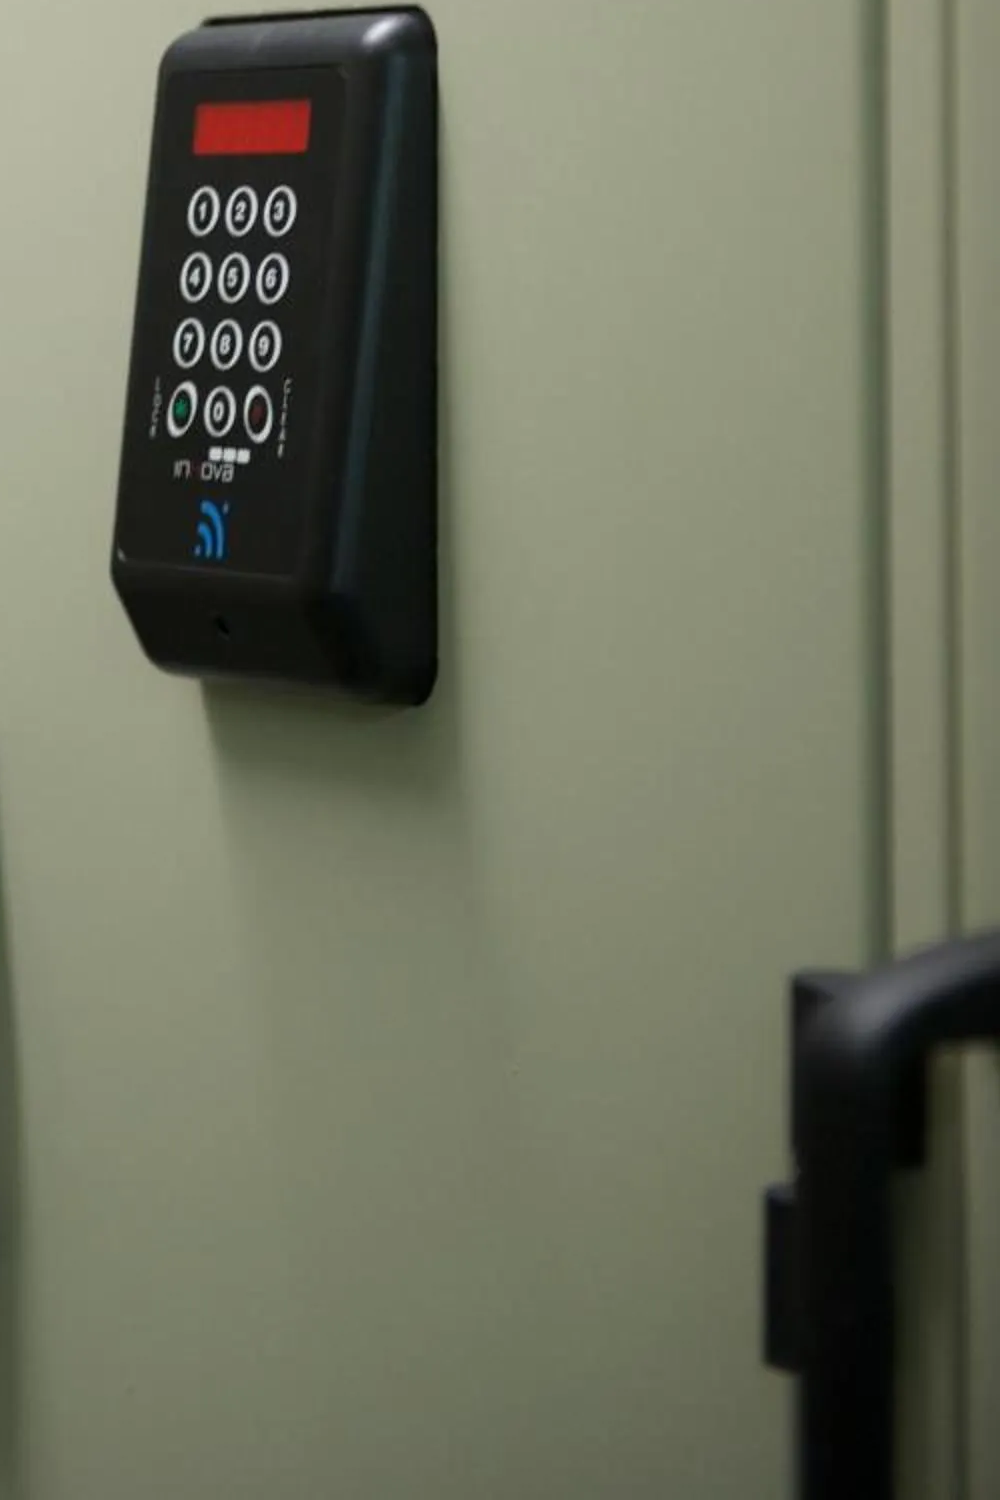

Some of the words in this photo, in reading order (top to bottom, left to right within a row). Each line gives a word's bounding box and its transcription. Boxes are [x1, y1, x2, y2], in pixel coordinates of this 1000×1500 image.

[198, 200, 208, 221] 1
[234, 200, 247, 222] 2
[272, 199, 285, 222] 3
[188, 266, 201, 288] 4
[226, 266, 239, 289] 5
[264, 267, 278, 290] 6
[183, 331, 195, 353] 7
[219, 333, 232, 356] 8
[257, 334, 270, 357] 9
[212, 400, 225, 423] 0
[173, 459, 235, 483] inova
